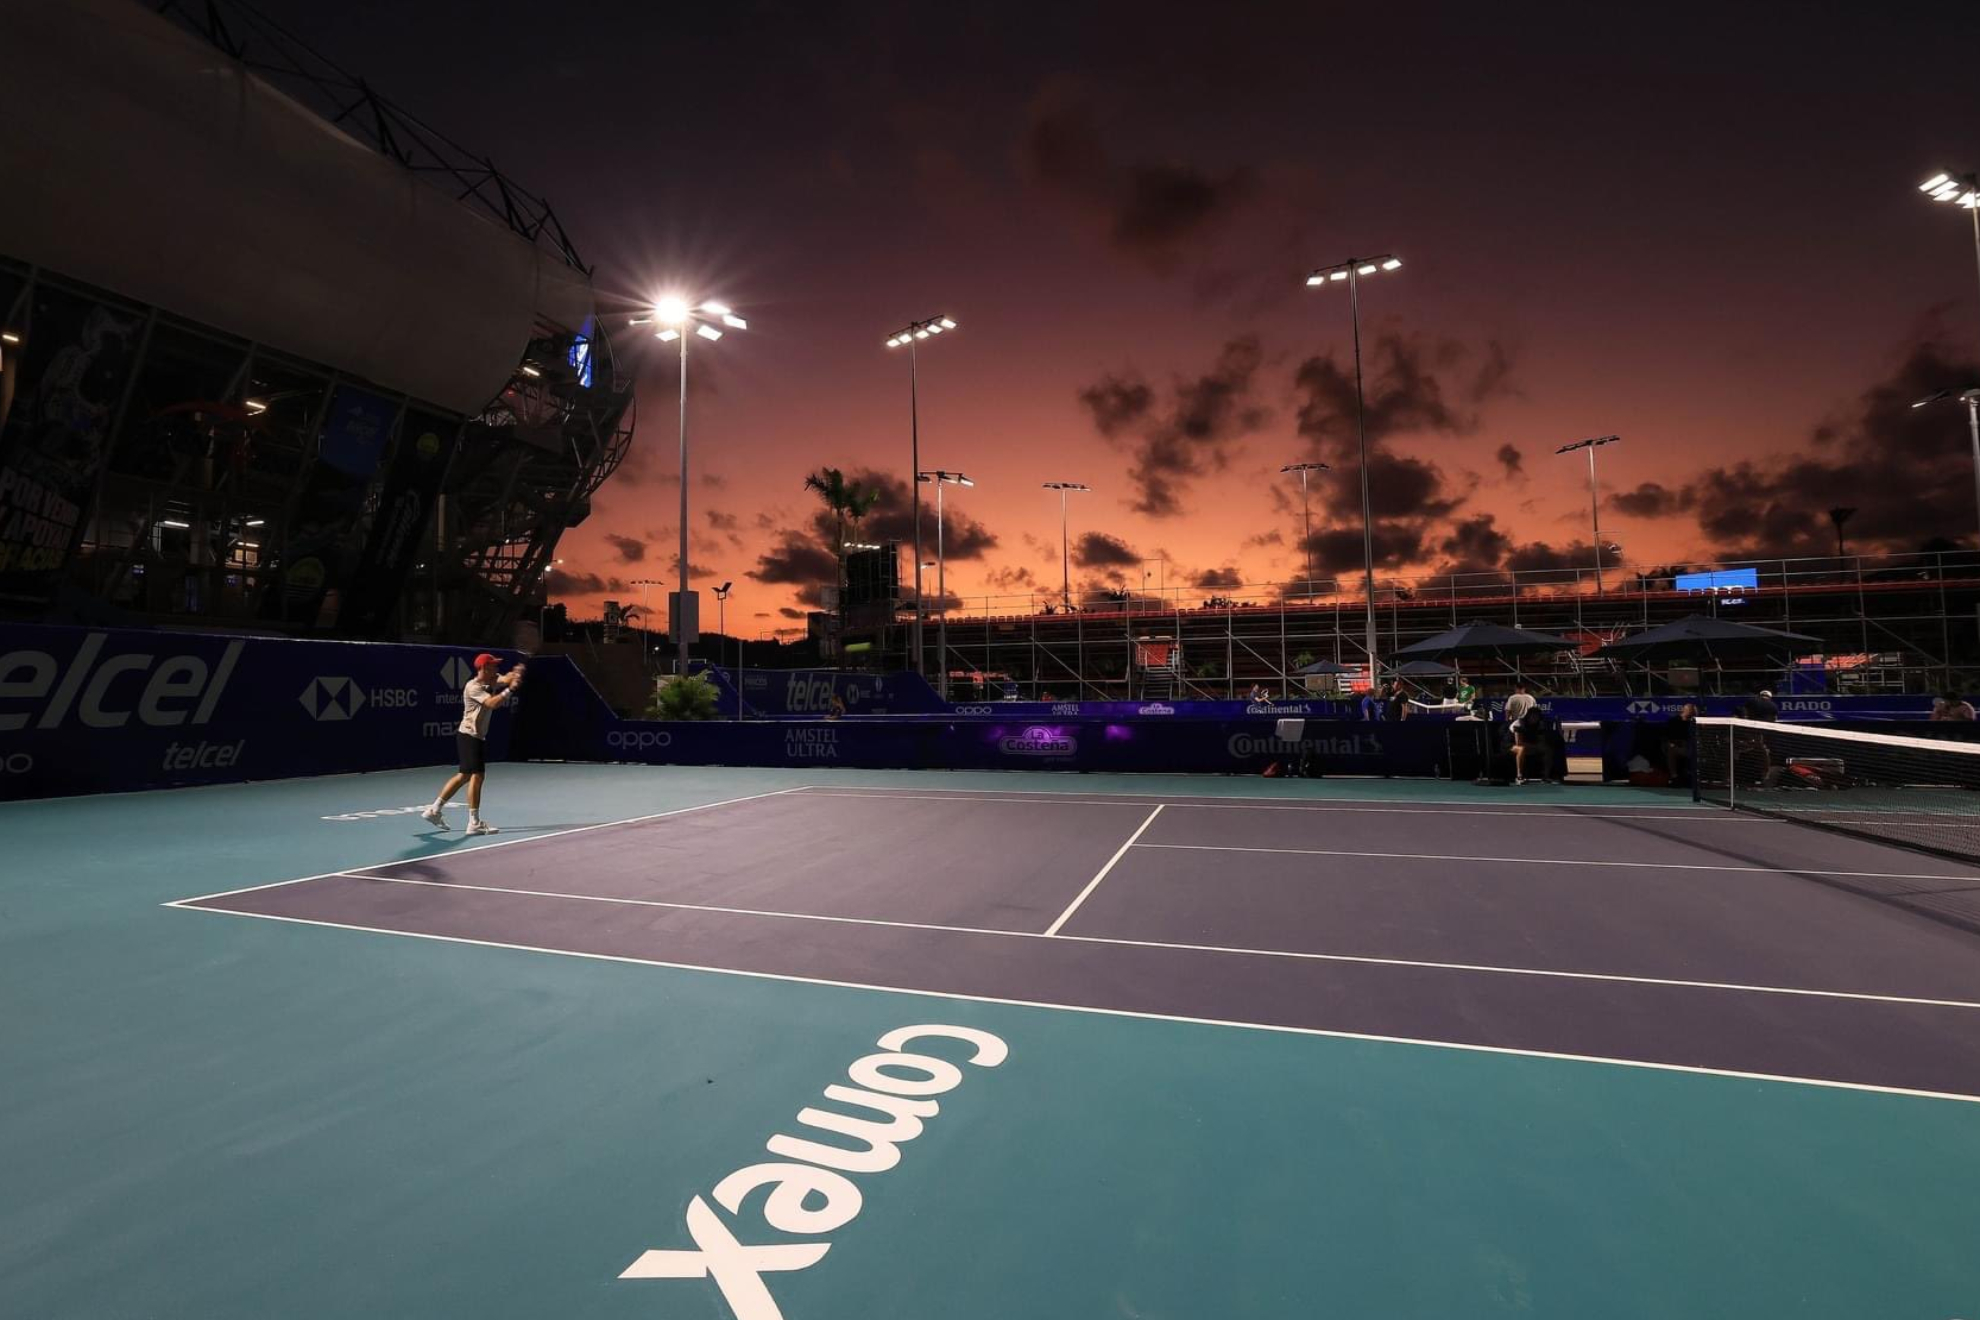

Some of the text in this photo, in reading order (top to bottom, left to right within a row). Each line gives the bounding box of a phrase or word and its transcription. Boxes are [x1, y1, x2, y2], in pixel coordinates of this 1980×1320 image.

[0, 632, 246, 731] elcel
[370, 688, 418, 709] HSBC
[785, 672, 836, 712] telcel
[955, 706, 992, 716] oppo
[1051, 703, 1080, 712] AMSTEL
[1662, 704, 1685, 712] HSB
[1781, 701, 1831, 711] RADO
[606, 730, 672, 750] oppo
[784, 728, 839, 743] AMSTEL
[1031, 730, 1044, 739] La
[787, 743, 838, 758] ULTRA
[1006, 737, 1070, 751] Costeña
[1228, 733, 1361, 758] Continental
[162, 739, 246, 771] telcel
[617, 1024, 1009, 1320] comex
